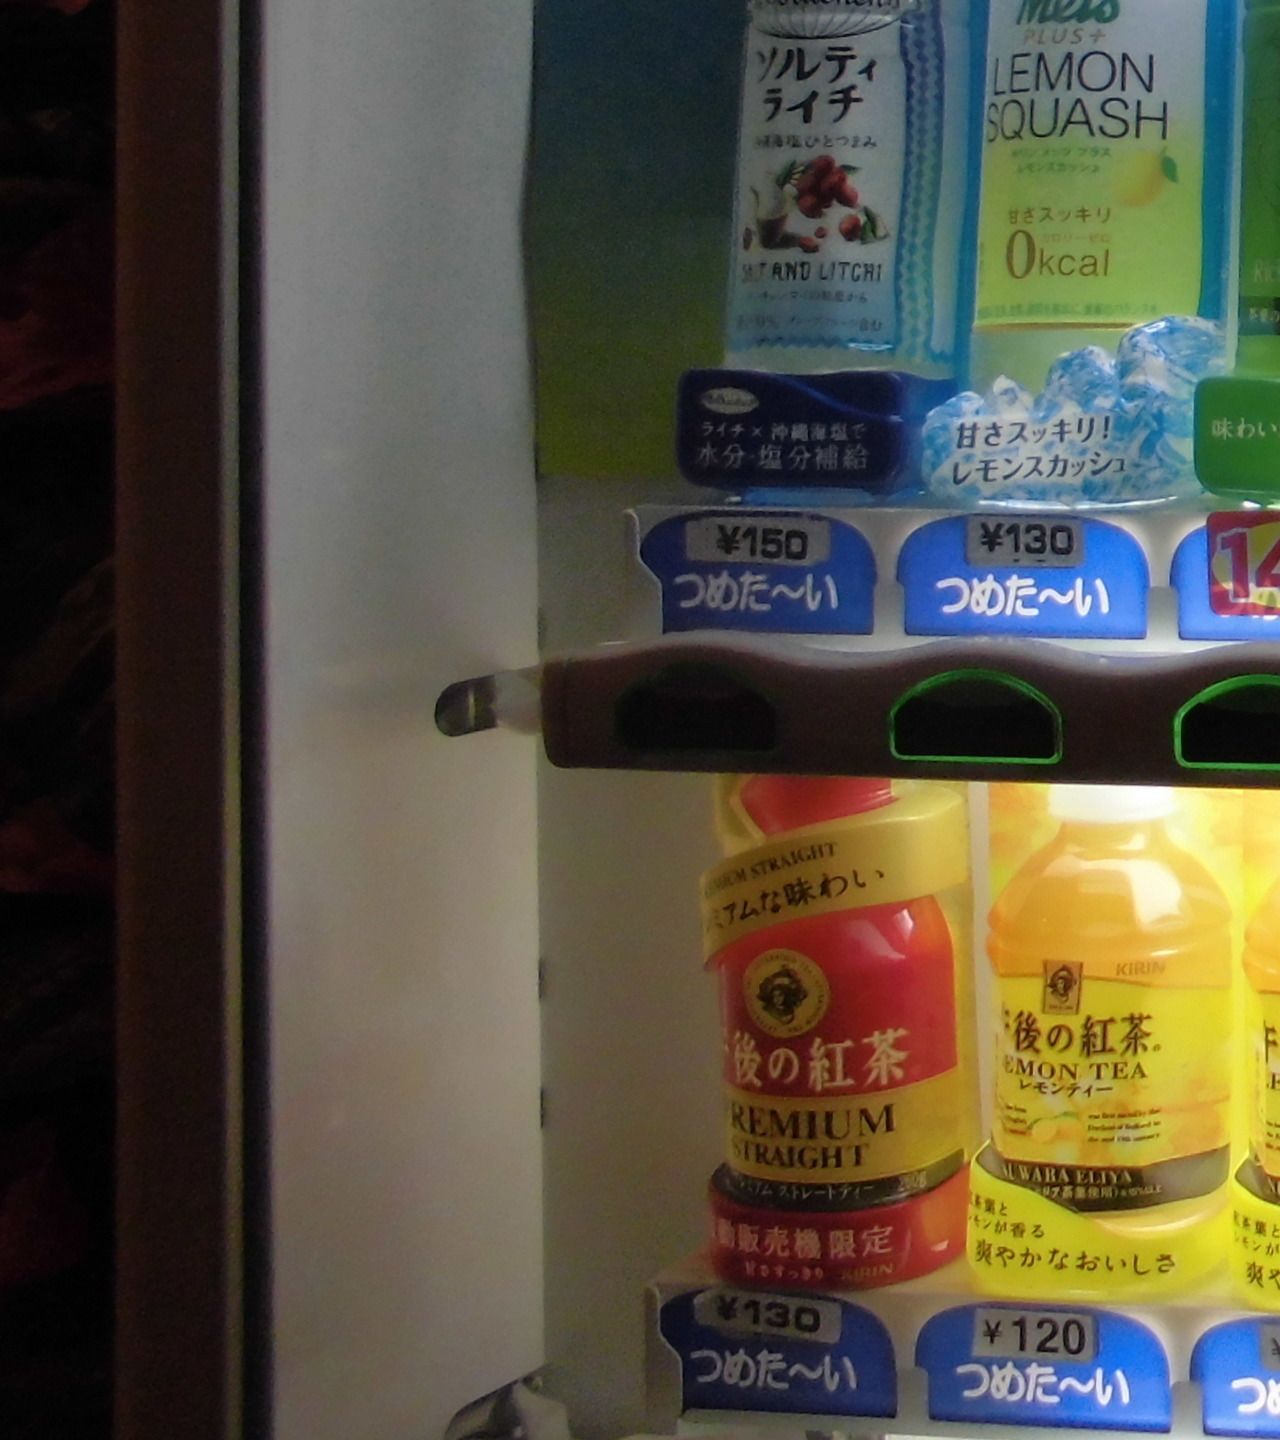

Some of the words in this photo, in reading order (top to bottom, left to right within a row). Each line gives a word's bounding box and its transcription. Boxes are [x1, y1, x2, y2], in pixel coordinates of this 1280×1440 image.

[994, 51, 1155, 95] LEMON
[763, 87, 864, 123] ライチ
[987, 98, 1168, 140] SQUASH
[952, 454, 1127, 486] レモンスカッシュ
[717, 525, 807, 559] ¥150
[981, 523, 1074, 554] ¥130
[1117, 962, 1165, 976] KIRIN
[1090, 1061, 1148, 1079] TEA
[1020, 1081, 1113, 1097] レモンティー
[976, 1239, 1176, 1275] 爽やかなおいしさ
[715, 1294, 820, 1332] ¥130
[984, 1317, 1086, 1354] ¥120
